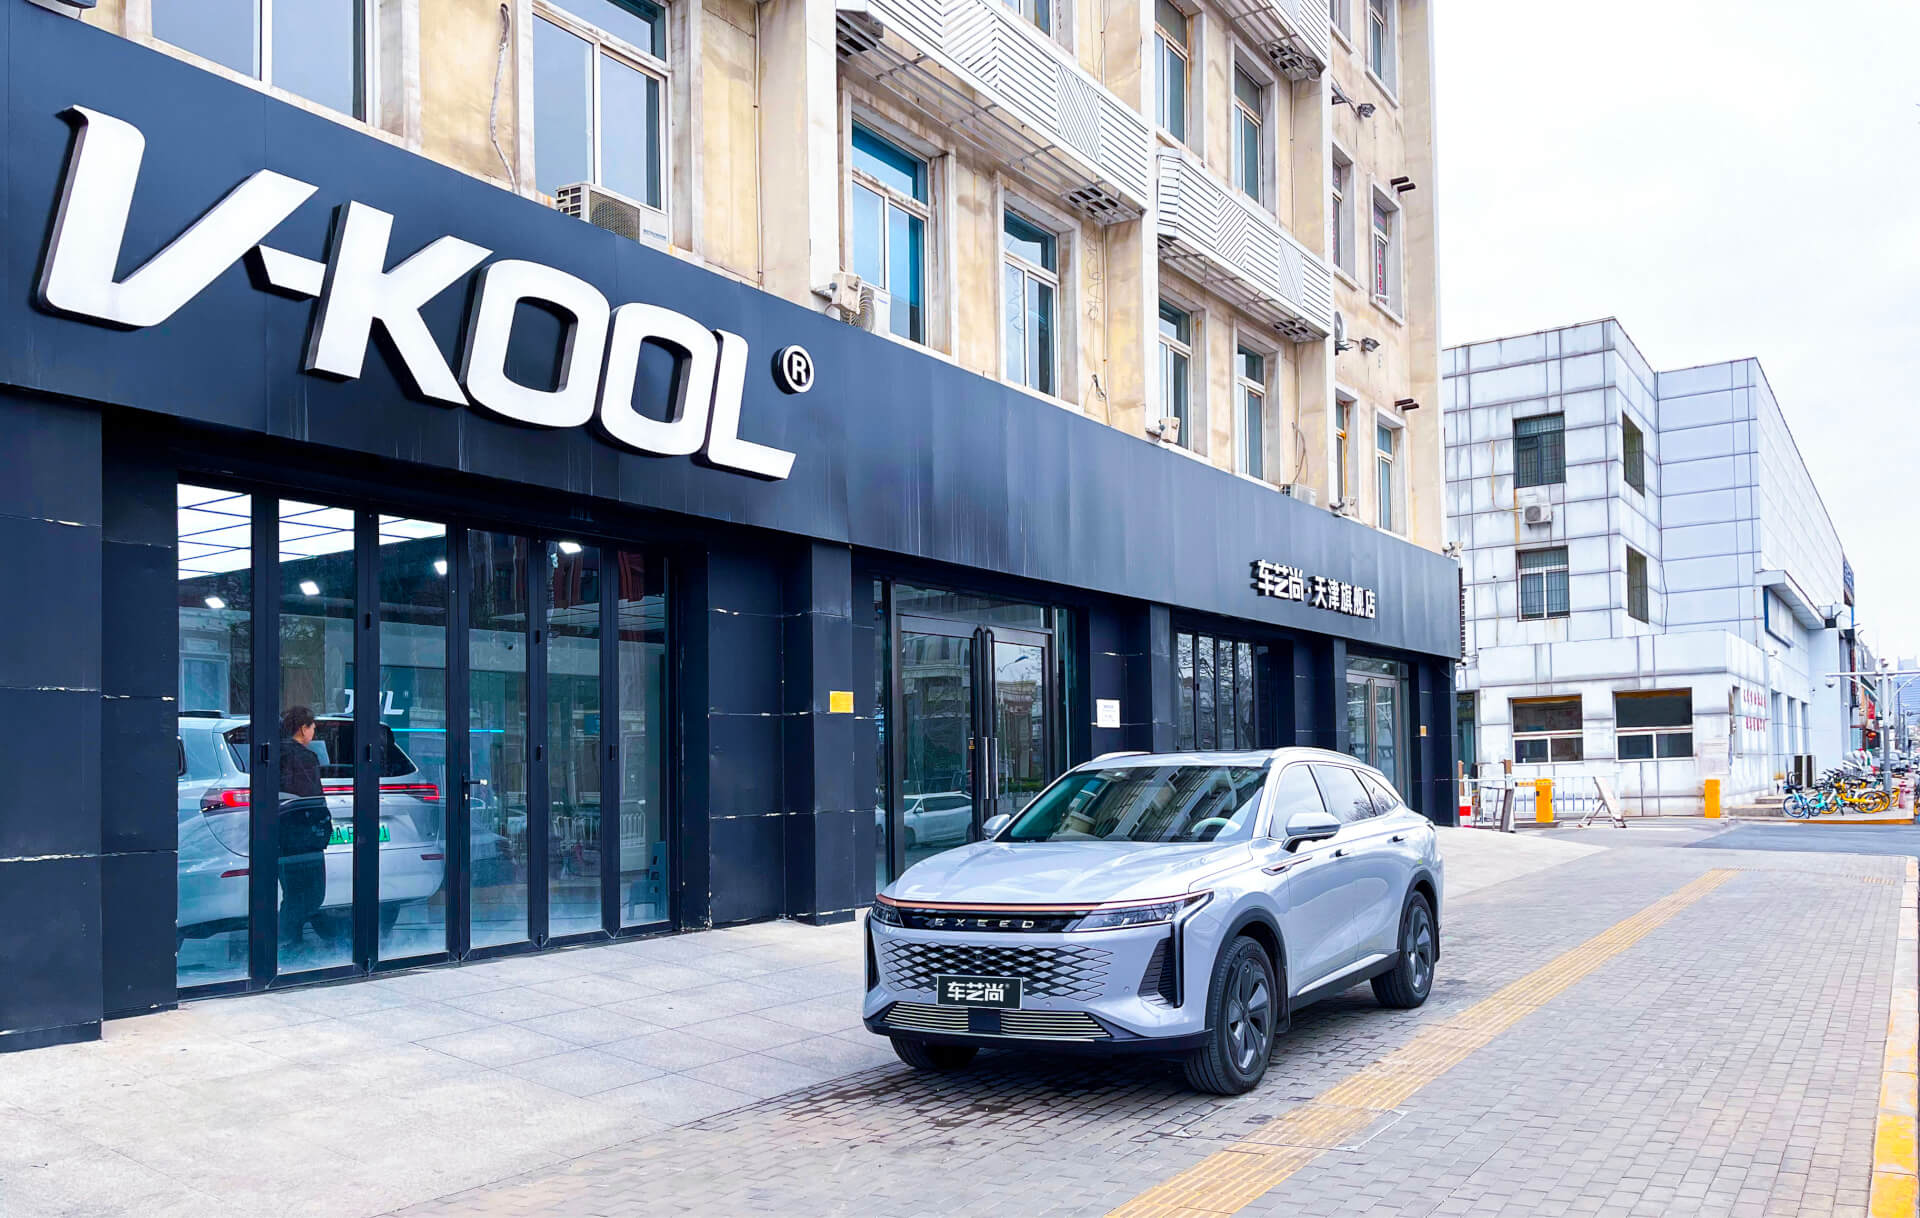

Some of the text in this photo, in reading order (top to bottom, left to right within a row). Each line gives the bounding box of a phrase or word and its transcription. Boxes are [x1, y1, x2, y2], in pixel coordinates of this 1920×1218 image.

[43, 104, 796, 480] V-KOOL
[934, 918, 1035, 928] EXEED
[946, 981, 1004, 1002] 车艺尚
